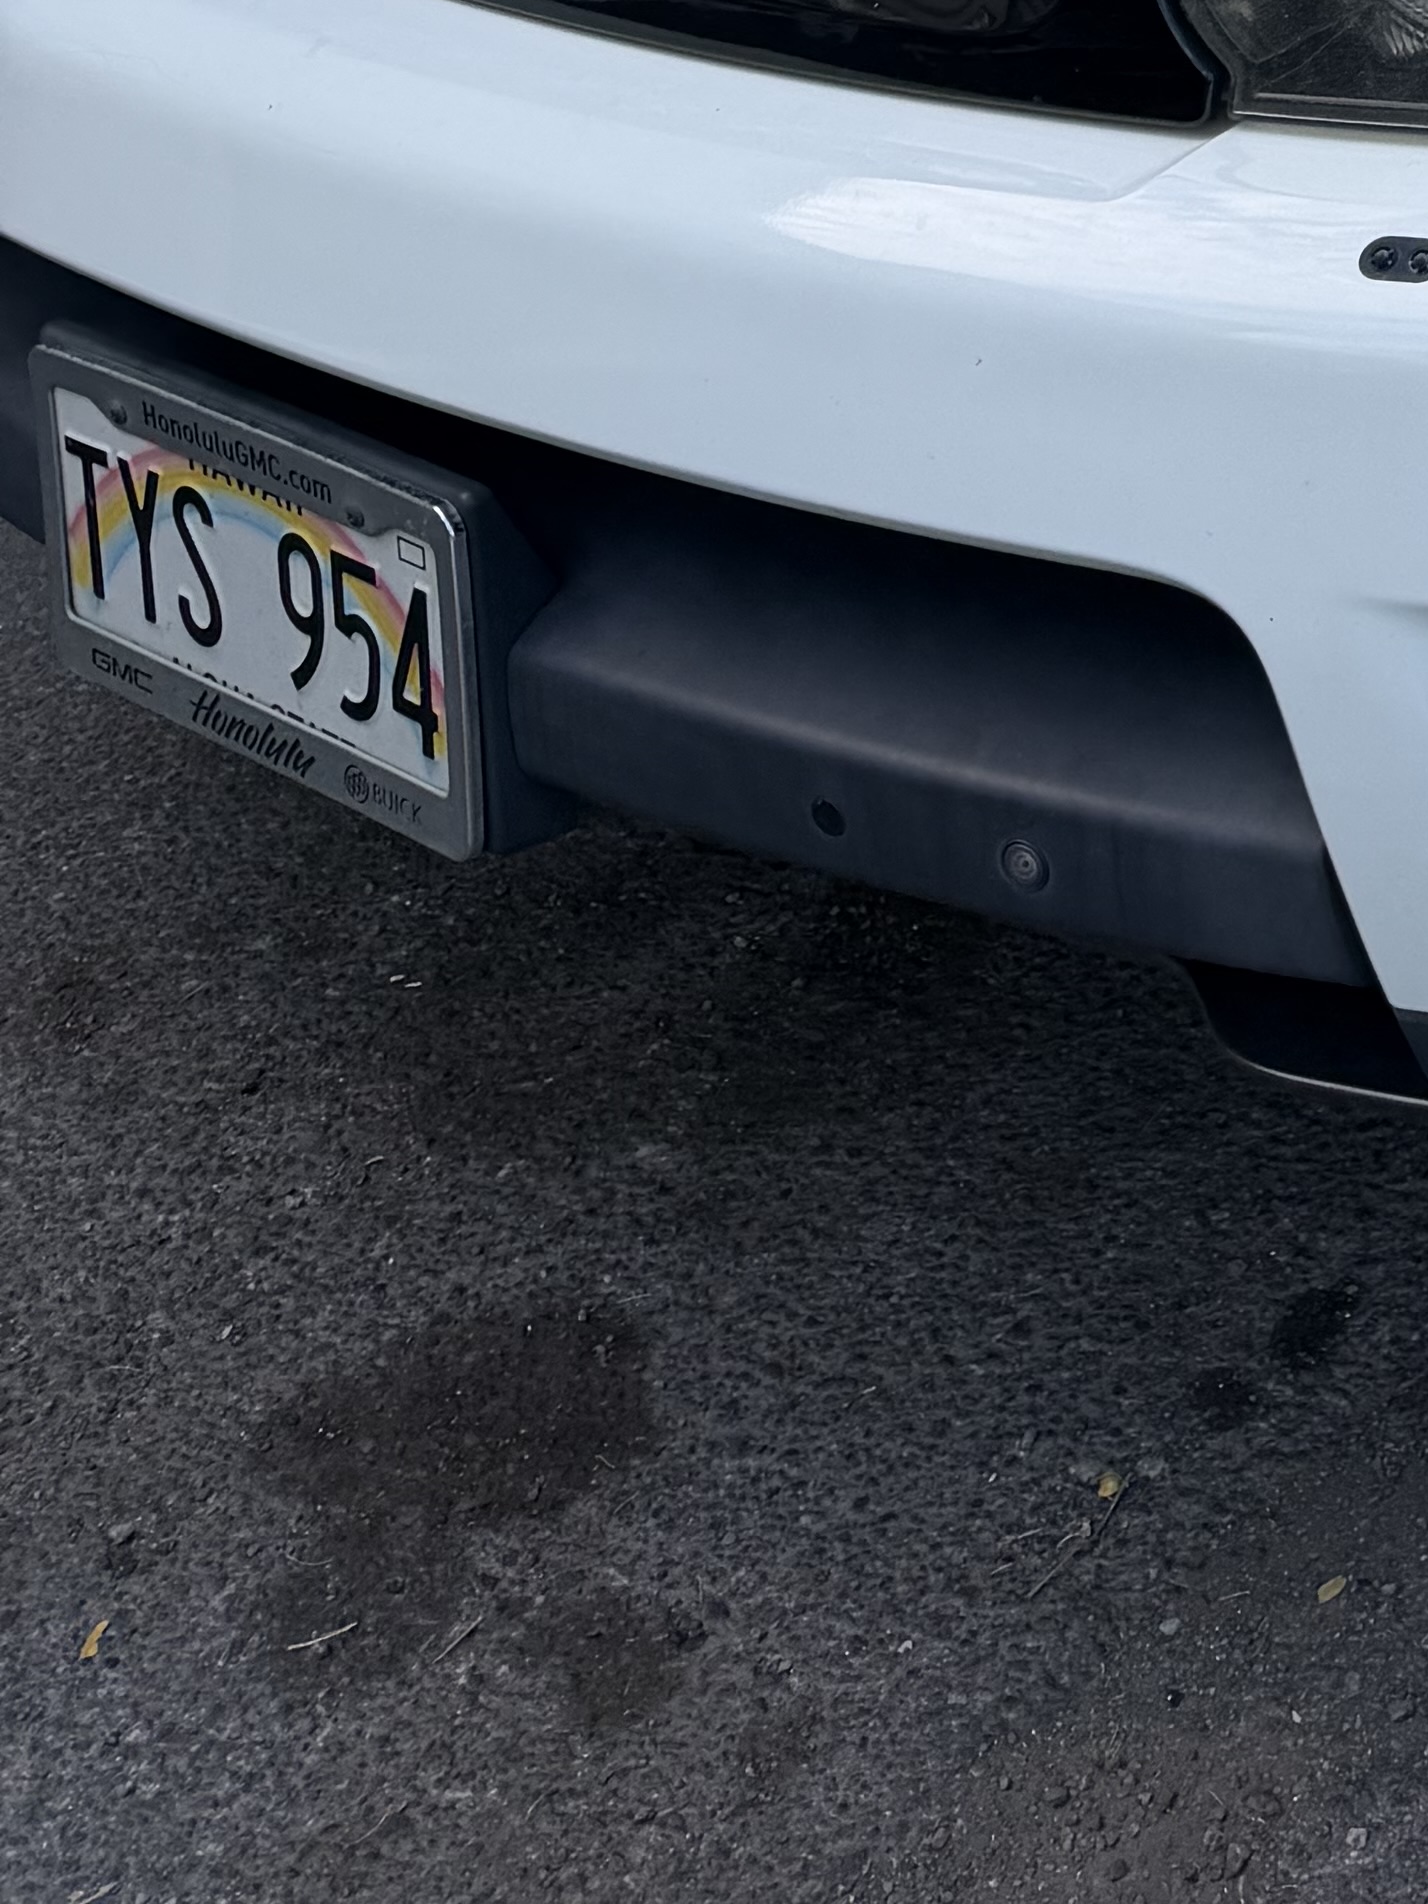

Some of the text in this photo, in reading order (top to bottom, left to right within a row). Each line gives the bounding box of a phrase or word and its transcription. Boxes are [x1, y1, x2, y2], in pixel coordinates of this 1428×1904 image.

[142, 399, 333, 505] HonoluluGMC.com
[64, 432, 222, 649] TYS
[276, 531, 439, 761] 954
[91, 647, 153, 694] GMC
[188, 689, 316, 779] Honolulu
[372, 781, 423, 826] BUICK
